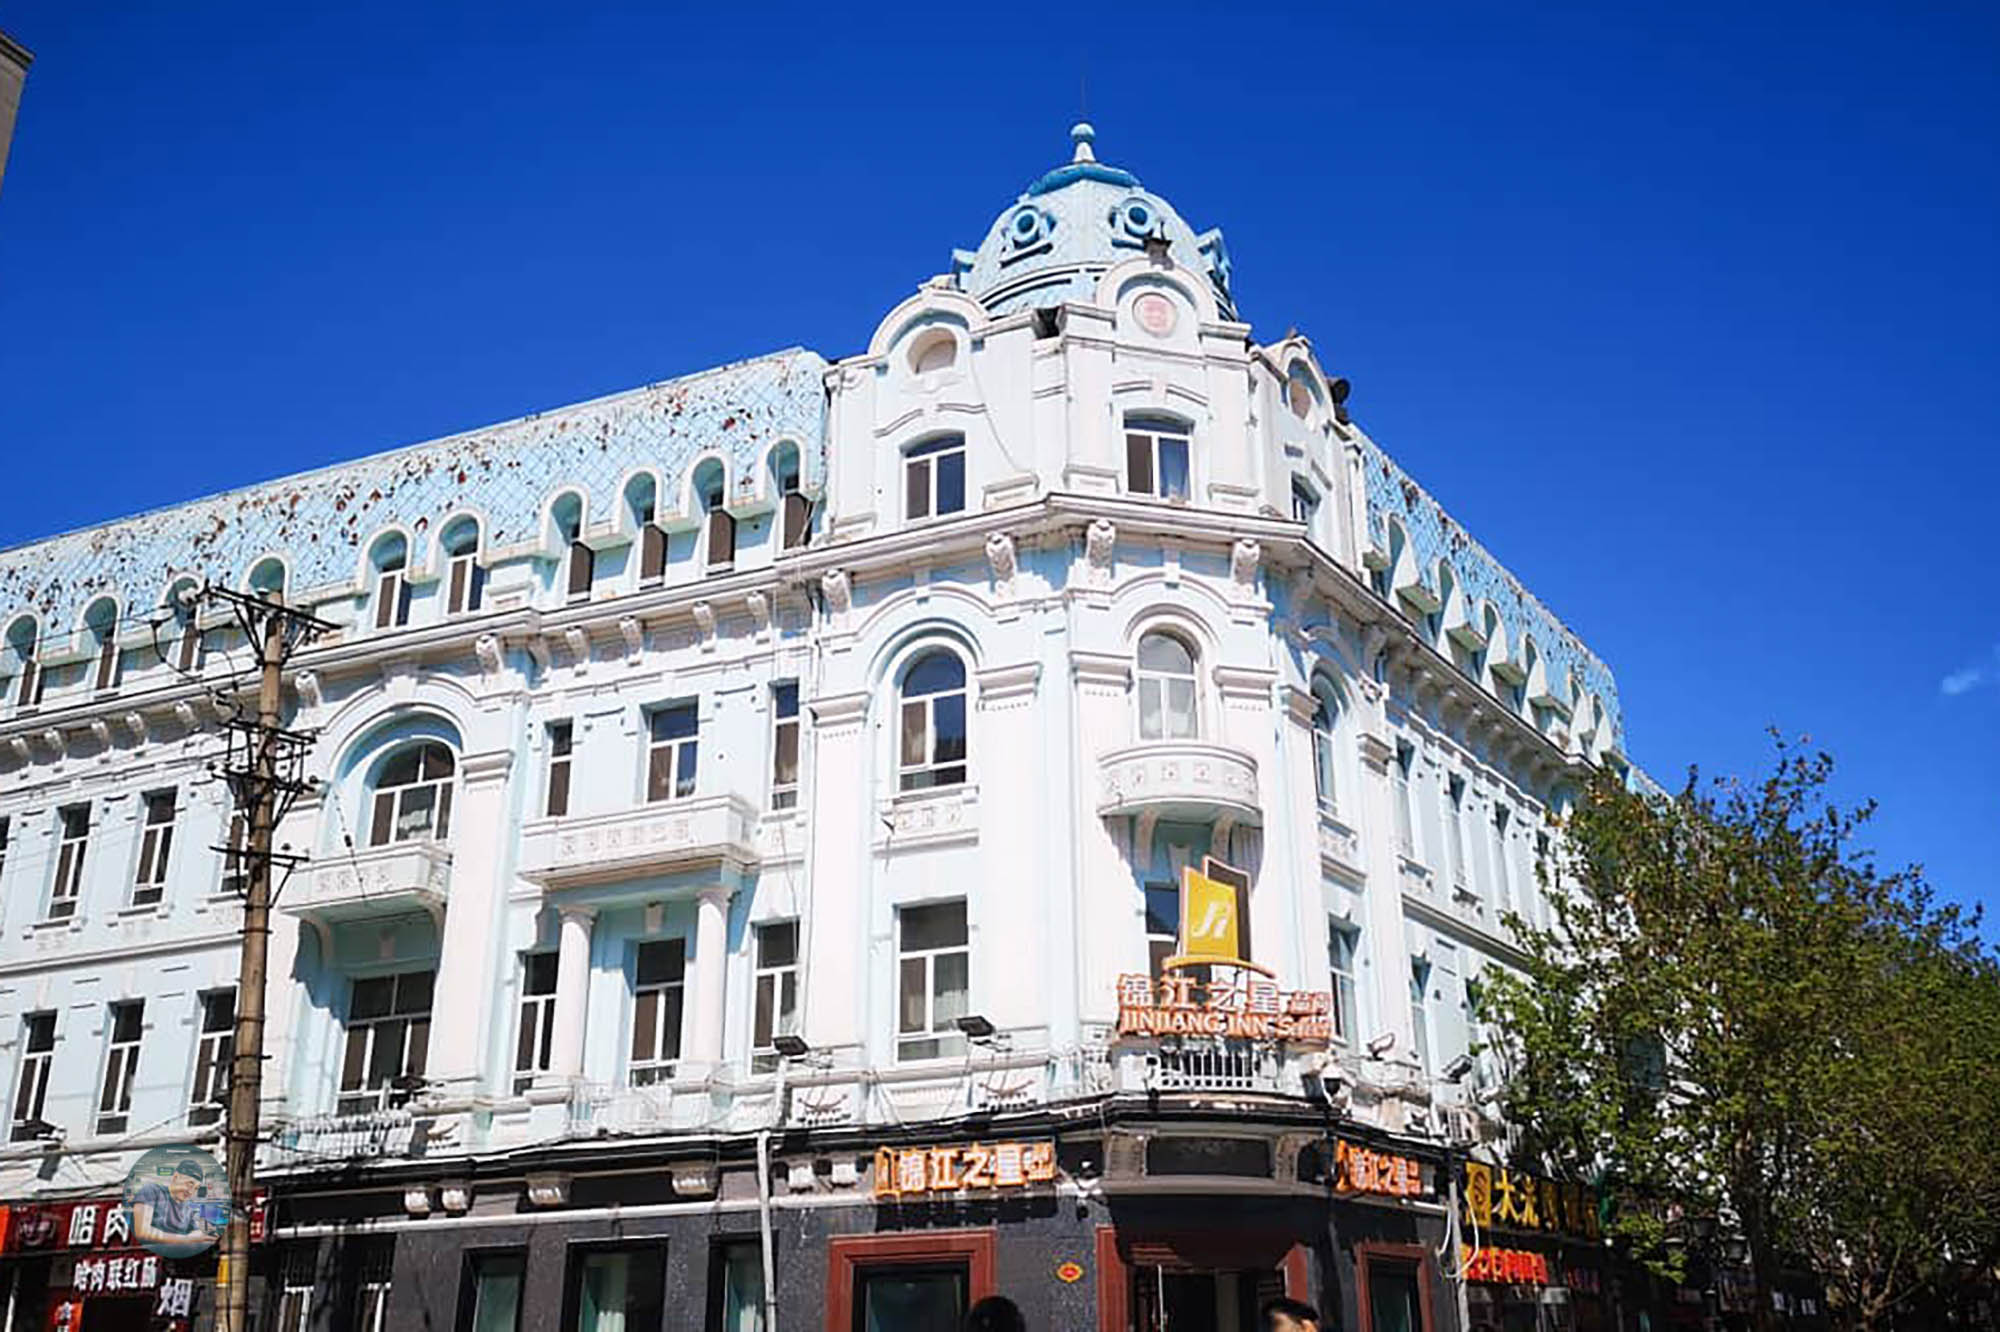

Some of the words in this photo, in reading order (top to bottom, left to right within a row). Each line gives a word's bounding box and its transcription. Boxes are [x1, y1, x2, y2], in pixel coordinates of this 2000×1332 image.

[1118, 973, 1280, 1015] 锦江之星
[1120, 1008, 1219, 1036] JINJIANG
[1227, 1012, 1268, 1038] INN
